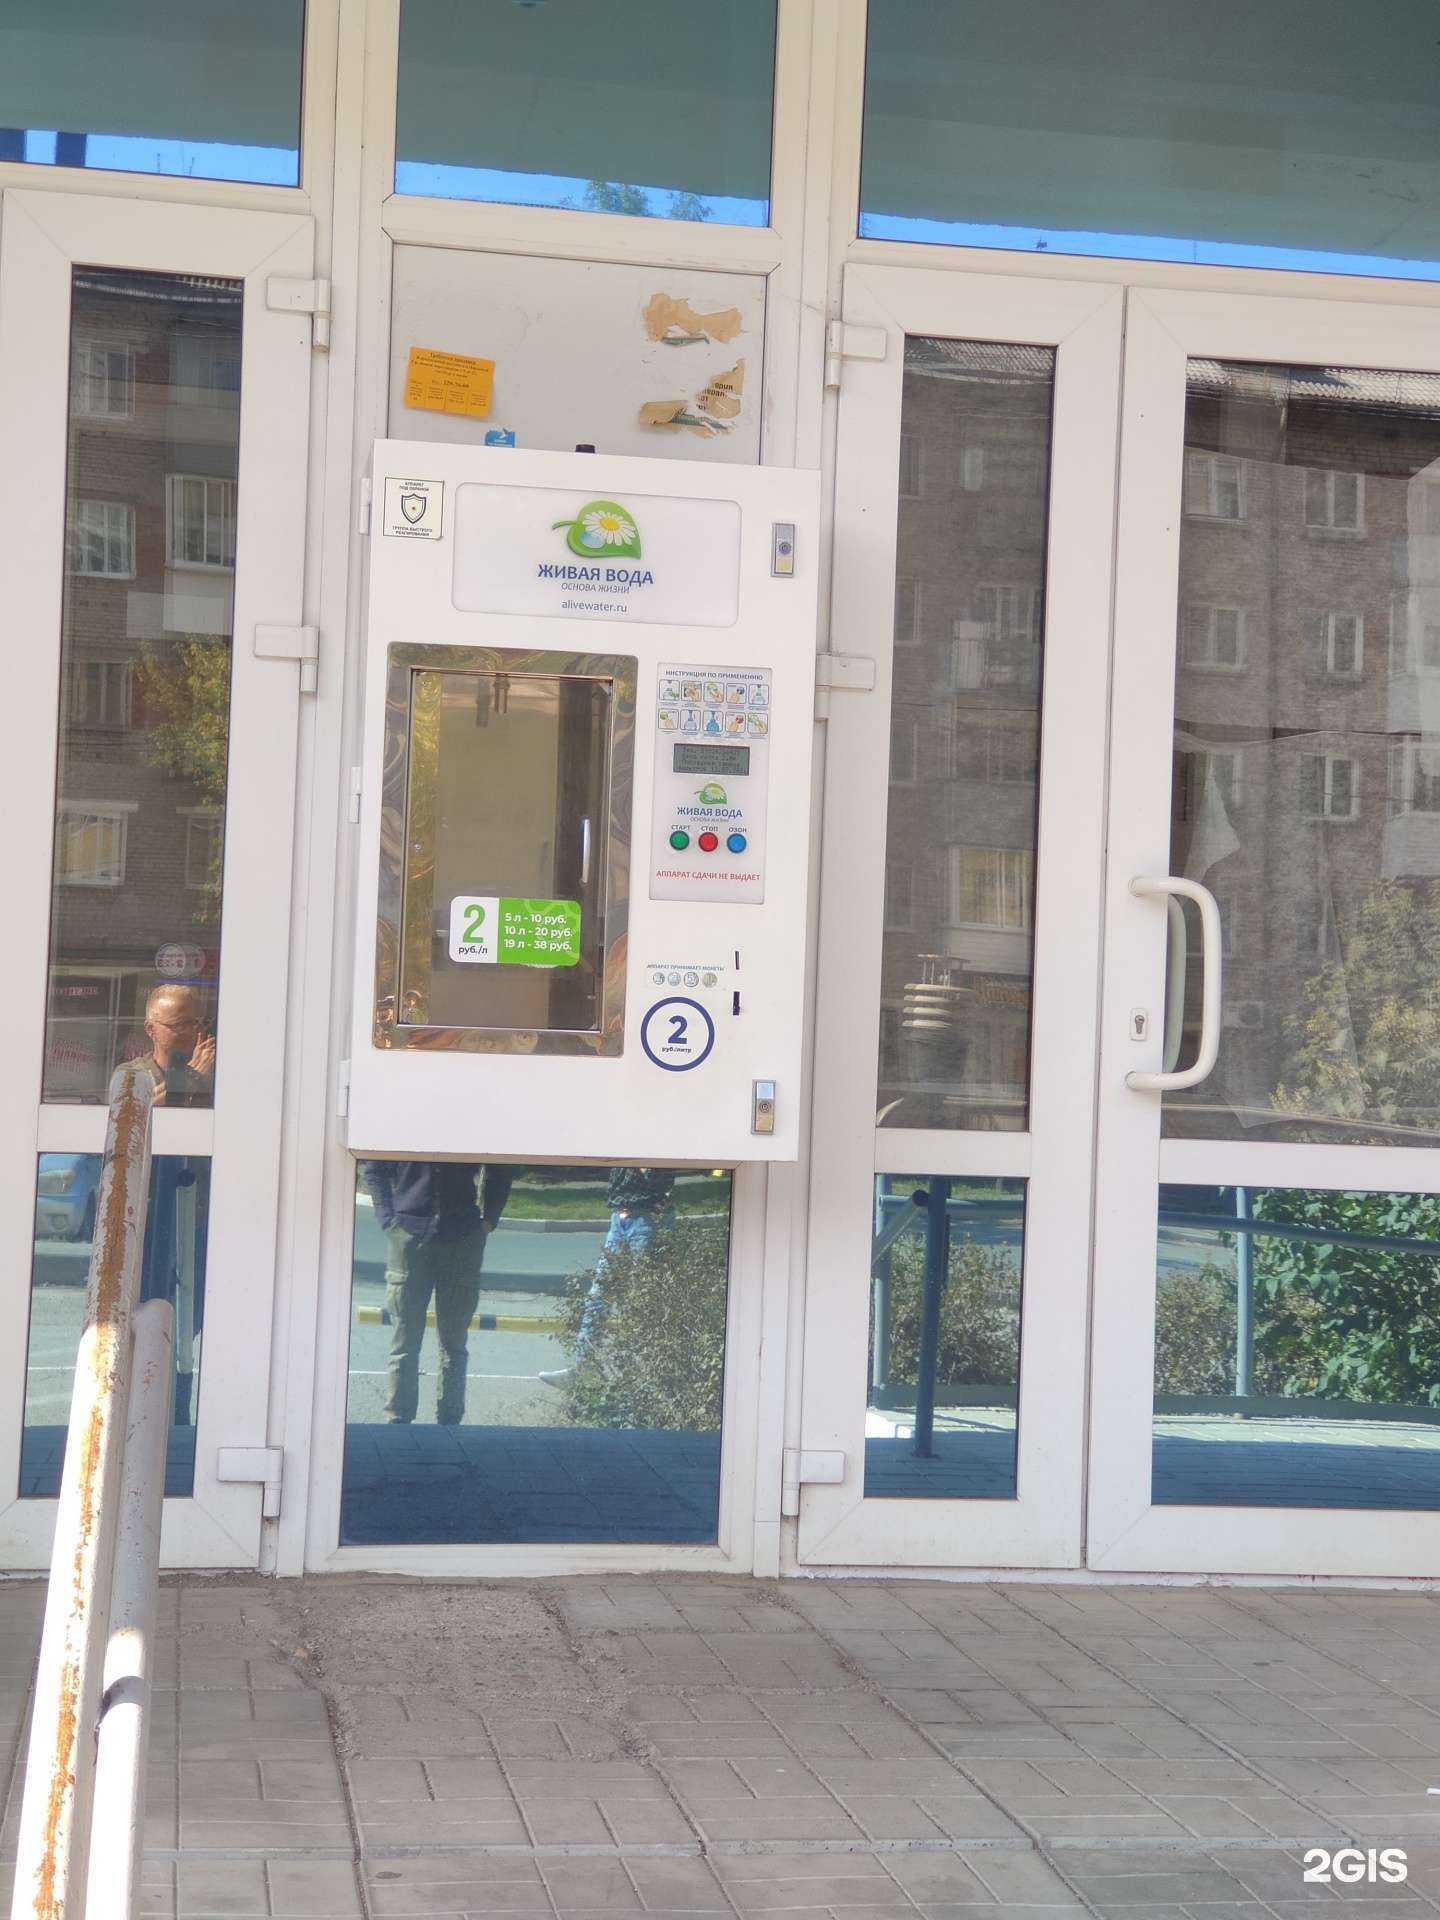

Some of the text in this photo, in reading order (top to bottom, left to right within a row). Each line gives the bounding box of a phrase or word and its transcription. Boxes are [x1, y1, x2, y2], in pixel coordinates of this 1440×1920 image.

[537, 564, 654, 588] ЖИВАЯ ВОДА
[561, 582, 630, 594] ОСНОВА ЖИЗНИ
[561, 600, 628, 613] alivewater.ru
[665, 670, 707, 679] ИНСТРУКЦИЯ
[717, 673, 764, 681] ПРИМЕНЕНИЮ
[677, 807, 743, 819] ЖИВАЯ ВОДА
[656, 870, 760, 882] АППАРАТ СДАЧИ НЕ ВЫДАЕТ
[462, 904, 486, 944] 2
[504, 912, 512, 922] 5
[513, 914, 522, 922] л
[531, 913, 542, 923] 10
[544, 914, 567, 925] руб.
[504, 926, 516, 935] 10
[517, 928, 526, 936] л
[534, 927, 549, 936] 20
[550, 928, 573, 939] руб.
[458, 945, 488, 955] руб./л
[504, 939, 516, 948] 19
[517, 941, 525, 949] л
[534, 940, 547, 950] 38
[549, 941, 573, 952] руб.
[668, 1015, 688, 1044] 2
